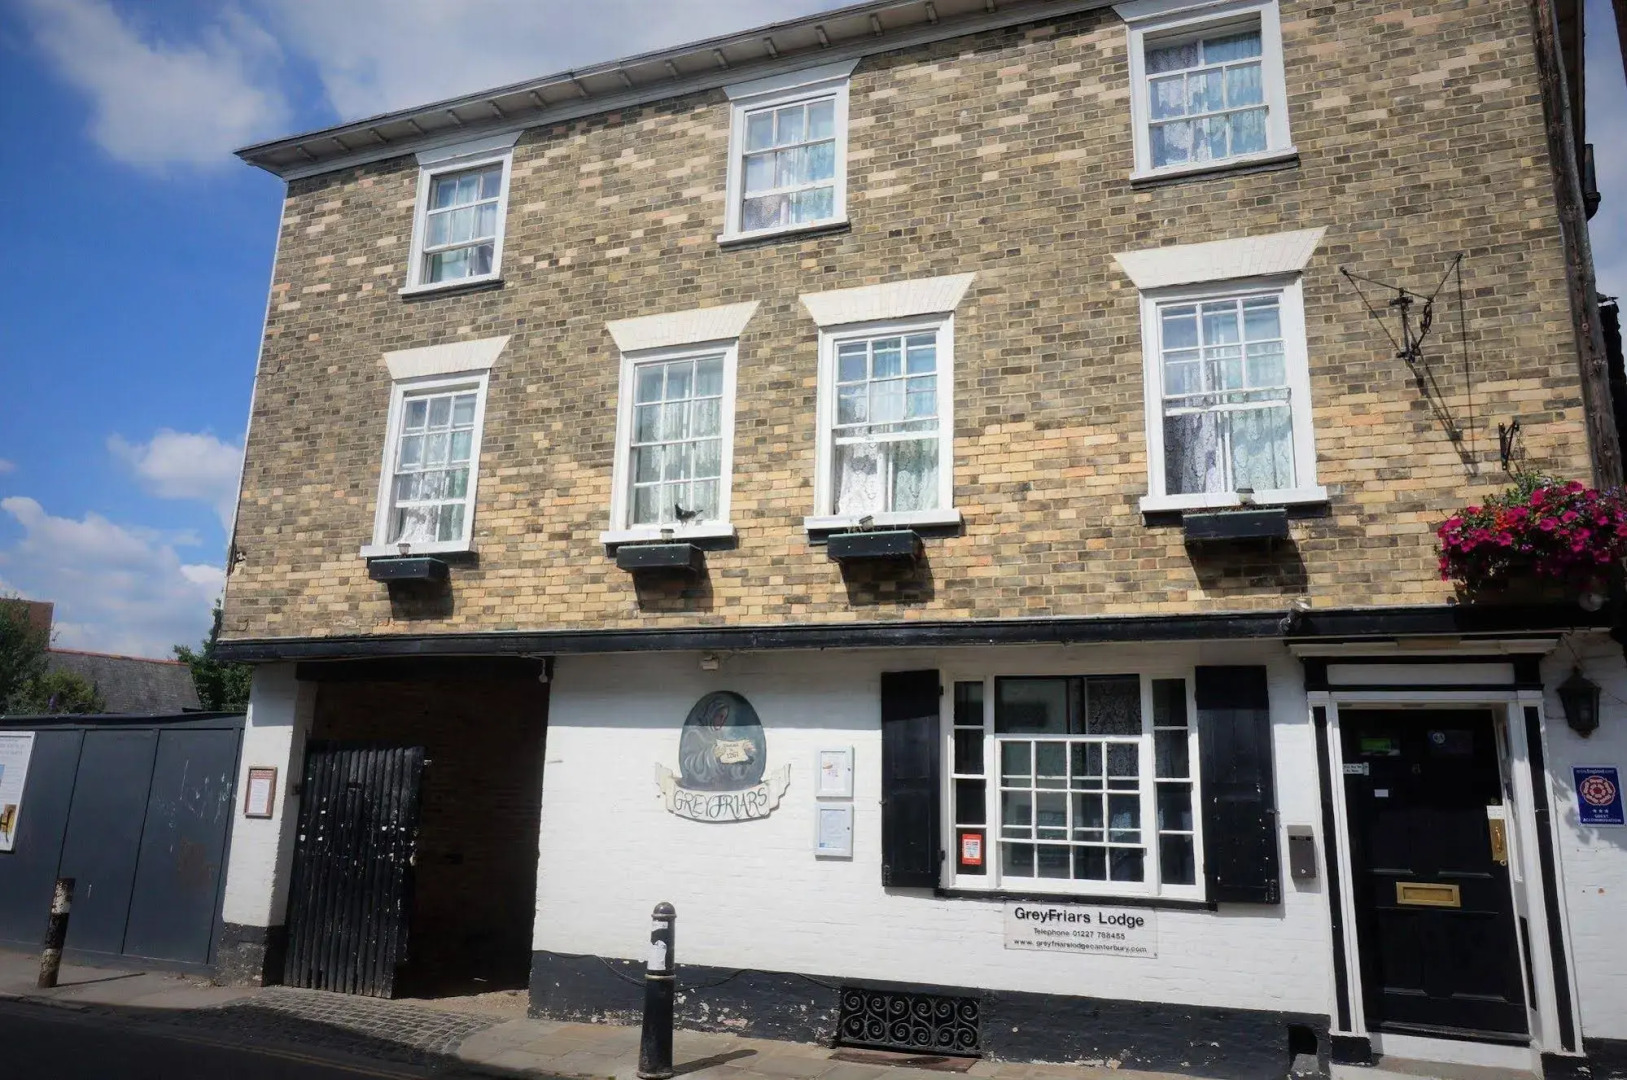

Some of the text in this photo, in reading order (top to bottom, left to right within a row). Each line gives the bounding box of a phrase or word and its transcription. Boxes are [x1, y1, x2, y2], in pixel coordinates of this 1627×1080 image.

[674, 787, 767, 819] GREYFRIARS
[1014, 907, 1144, 928] GreyFriars Lodge
[1033, 928, 1070, 937] Telephone
